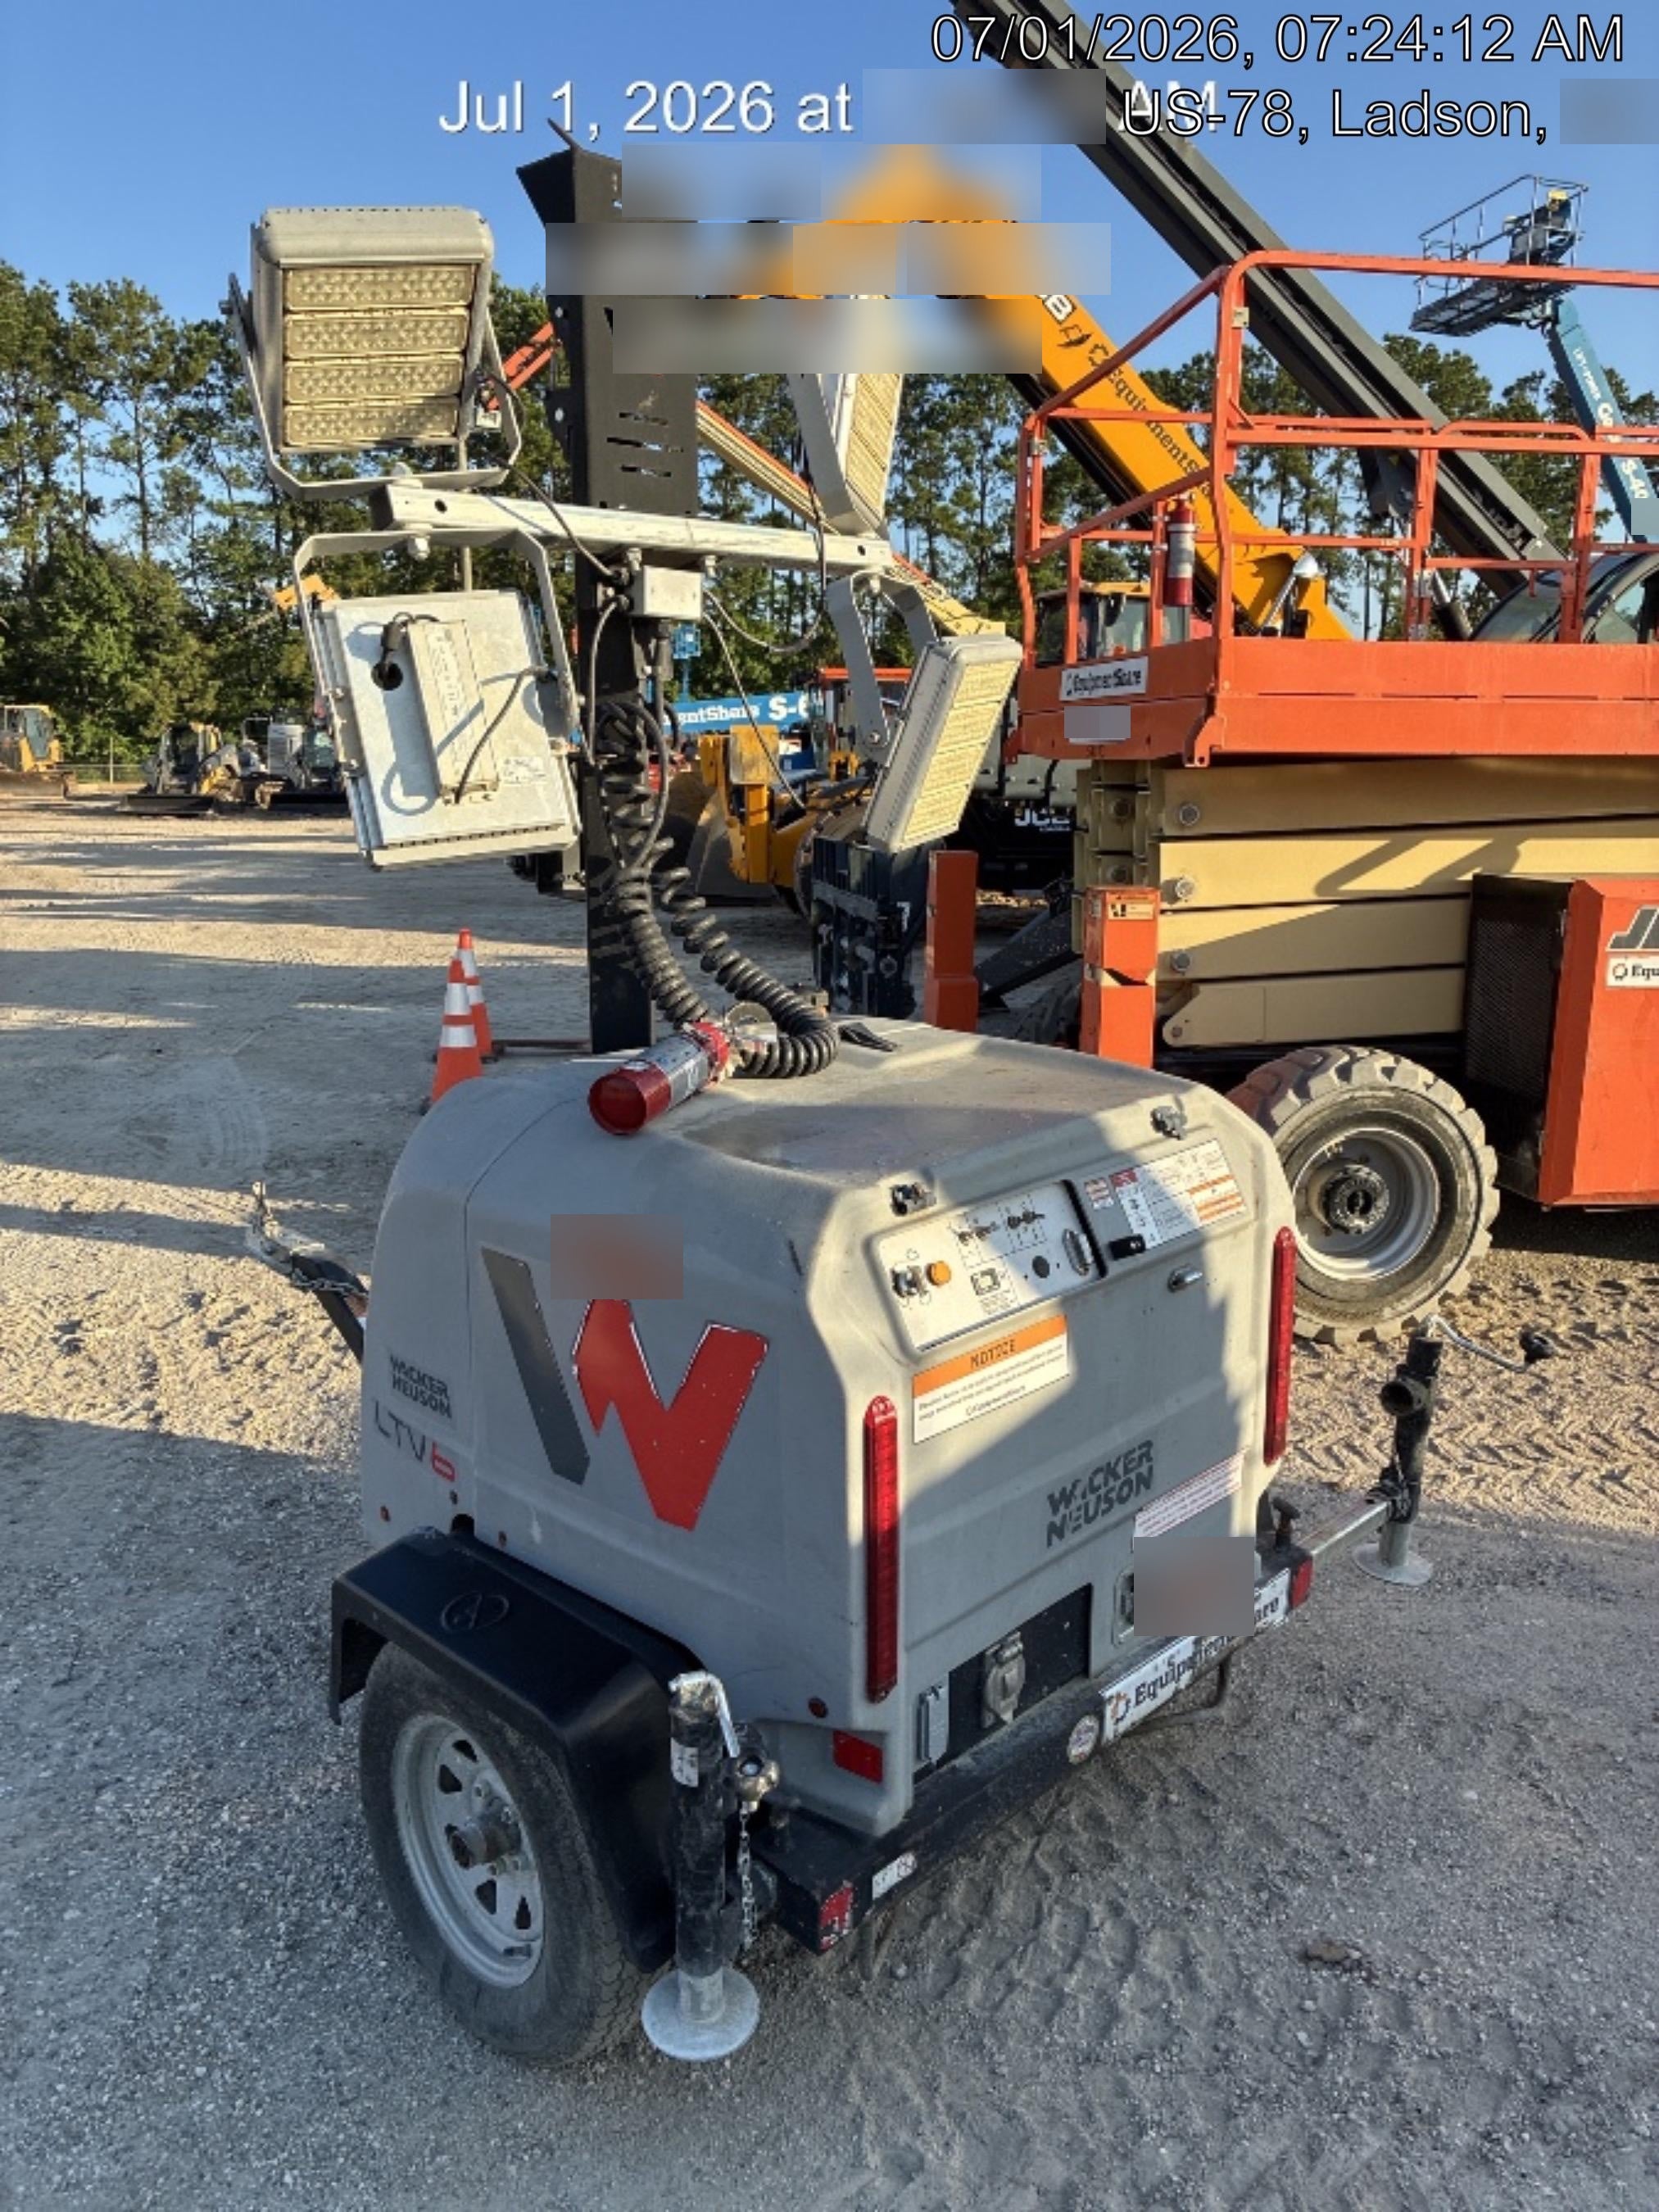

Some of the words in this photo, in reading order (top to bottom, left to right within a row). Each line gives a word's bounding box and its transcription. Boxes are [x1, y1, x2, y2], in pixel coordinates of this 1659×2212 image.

[969, 1339, 1017, 1369] NOTICE
[392, 1374, 452, 1419] NEUSON
[1046, 1465, 1154, 1548] NEUSON
[1047, 1439, 1154, 1516] WACKER
